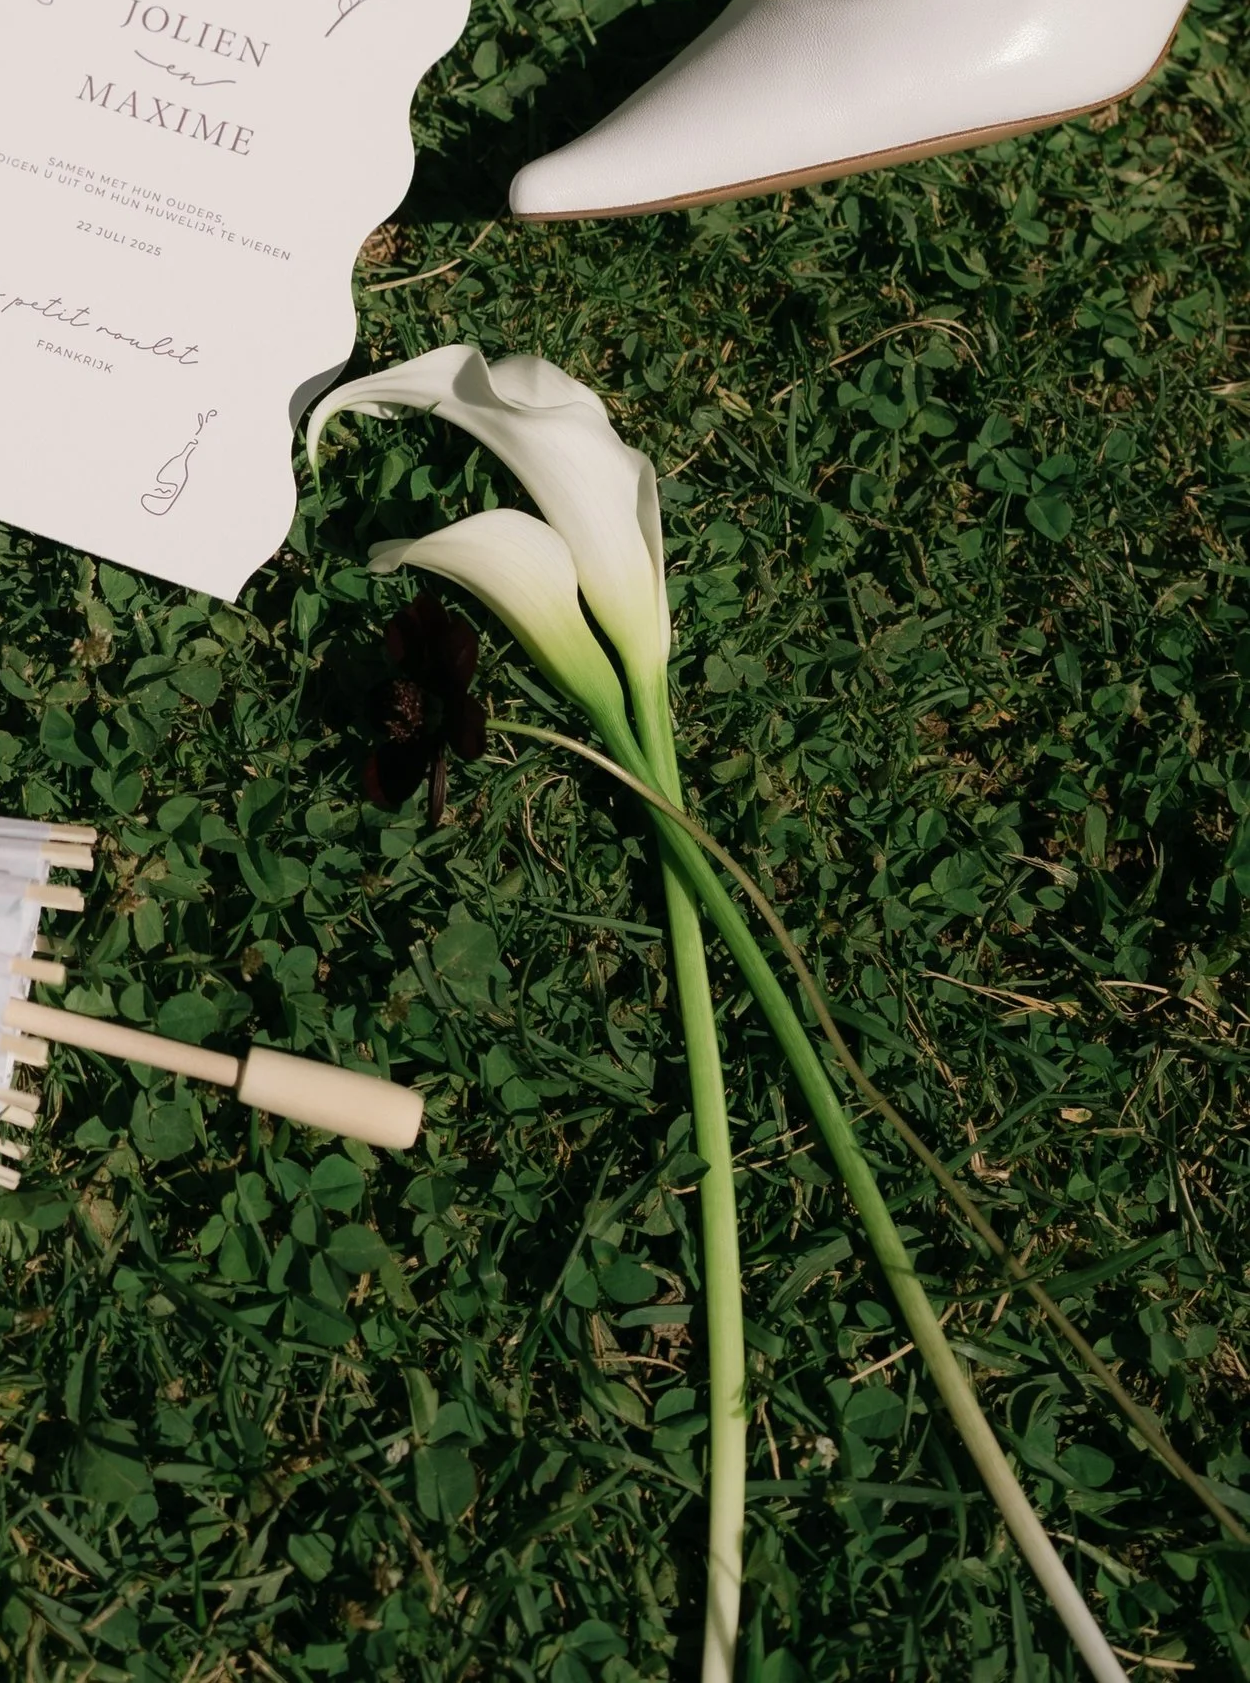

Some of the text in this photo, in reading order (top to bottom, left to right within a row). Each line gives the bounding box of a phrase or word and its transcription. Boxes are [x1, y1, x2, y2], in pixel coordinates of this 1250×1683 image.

[133, 49, 237, 87] en
[75, 73, 255, 157] MAXIME
[43, 168, 54, 179] U
[57, 173, 81, 189] UIT
[84, 183, 106, 198] OM
[110, 191, 141, 210] HUN
[144, 203, 216, 237] HUWELIJK
[220, 228, 237, 243] TE
[241, 236, 291, 261] VIEREN
[47, 156, 225, 227] SAMEN MET HUN OUDERS,
[75, 219, 163, 257] 22 JULI 2025
[0, 296, 91, 327] petit
[95, 325, 200, 365] roulet
[36, 339, 114, 375] FRANKRIJK
